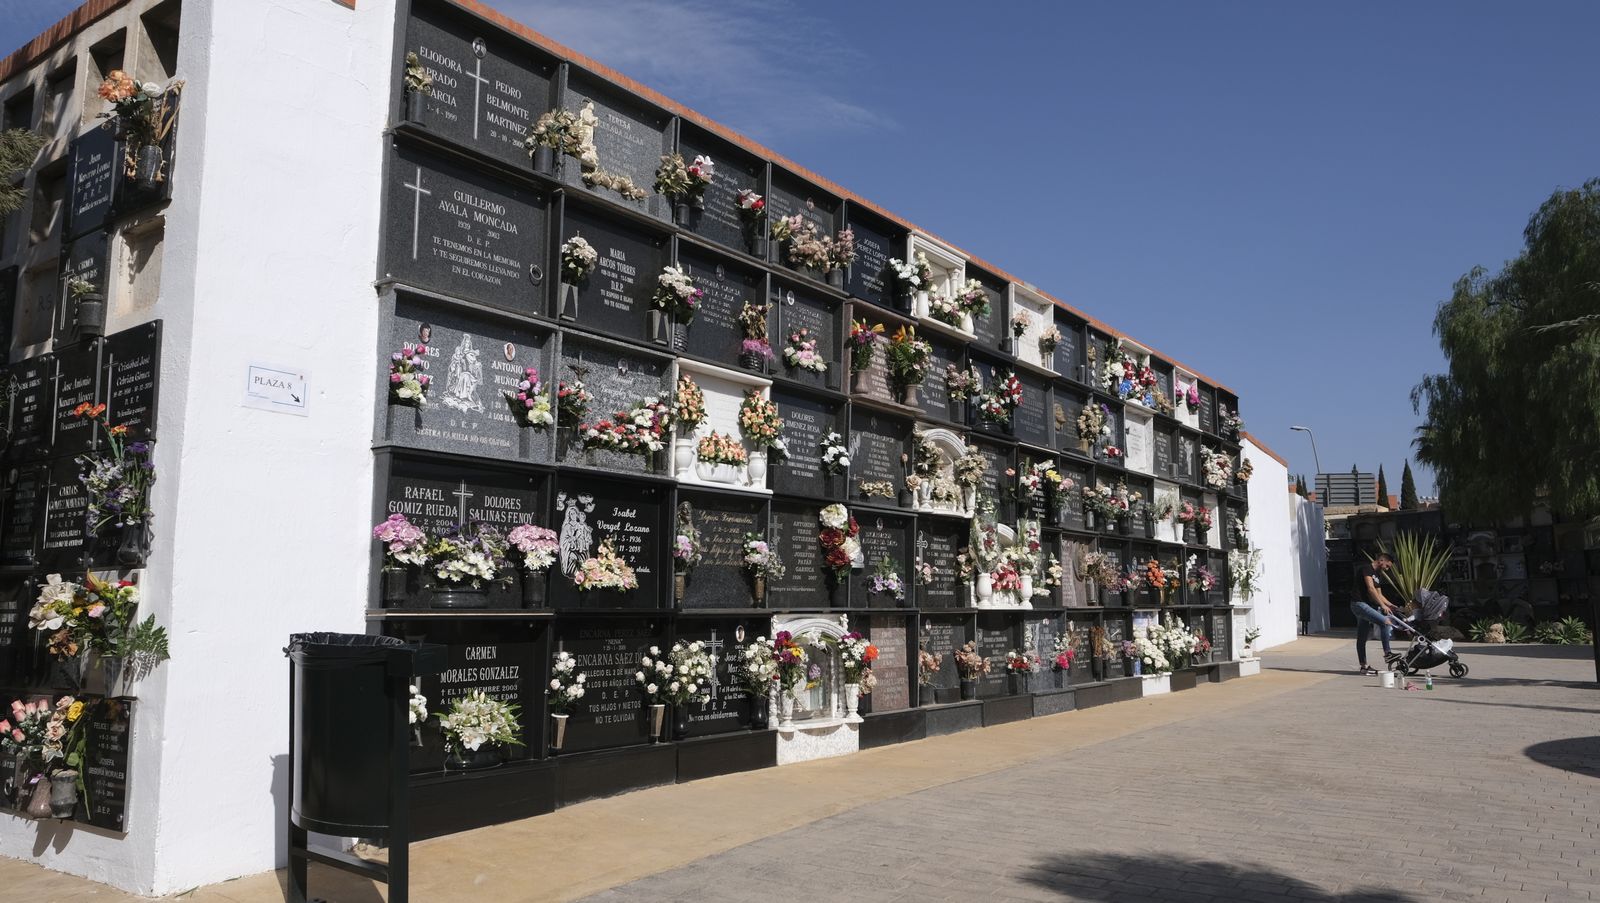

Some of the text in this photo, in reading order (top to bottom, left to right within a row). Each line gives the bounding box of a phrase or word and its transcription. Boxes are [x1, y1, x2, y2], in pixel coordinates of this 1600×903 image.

[420, 45, 462, 74] ELIODORA
[426, 67, 458, 89] PRADO
[429, 87, 457, 107] ARCIA
[495, 80, 522, 100] PEDRO
[486, 94, 529, 120] BELMONTE
[486, 112, 527, 137] MARTINEZ
[608, 114, 631, 131] TERESA
[89, 153, 102, 165] Juan
[454, 190, 506, 216] GUILLERMO
[438, 200, 518, 235] AYALA MONCADA
[856, 243, 872, 255] PEREZ
[864, 238, 881, 251] JOSEFA
[432, 235, 521, 270] TE TENEMOS EN LA MEMORIA
[610, 247, 626, 262] MARIA
[433, 248, 520, 279] Y TE SEGUIREMOS LLEVANDO
[600, 256, 617, 270] ARCOS
[616, 262, 636, 276] TORRES
[452, 264, 501, 286] EN EL CORAZON
[604, 298, 610, 306] NO
[491, 360, 523, 375] ANTONIO
[73, 376, 92, 389] Antonio
[254, 375, 292, 390] PLAZA 8
[494, 373, 520, 388] MUÑOZ
[493, 414, 504, 422] LOS
[791, 411, 815, 422] DOLORES
[786, 420, 807, 431] JIMENEZ
[442, 431, 469, 442] FAMILIA
[405, 486, 444, 501] RAFAEL
[388, 500, 458, 518] GOMIZ RUEDA
[484, 495, 521, 510] DOLORES
[469, 508, 534, 525] SALINAS FENOY
[612, 507, 637, 518] Isabel
[424, 518, 429, 526] 2
[432, 525, 450, 534] AÑOS
[596, 520, 621, 533] Vergel
[465, 646, 497, 660] CARMEN
[577, 652, 633, 667] ENCARNA SAEZ
[440, 665, 520, 684] MORALES GONZALEZ
[616, 668, 624, 676] DE
[447, 688, 456, 696] EL
[502, 684, 518, 692] 2003
[609, 678, 622, 687] AÑOS
[623, 678, 630, 686] DE
[589, 704, 600, 713] TUS
[600, 702, 617, 712] HIJOS
[622, 700, 641, 710] NIETOS
[595, 713, 635, 724] NO TE OLVIDAN
